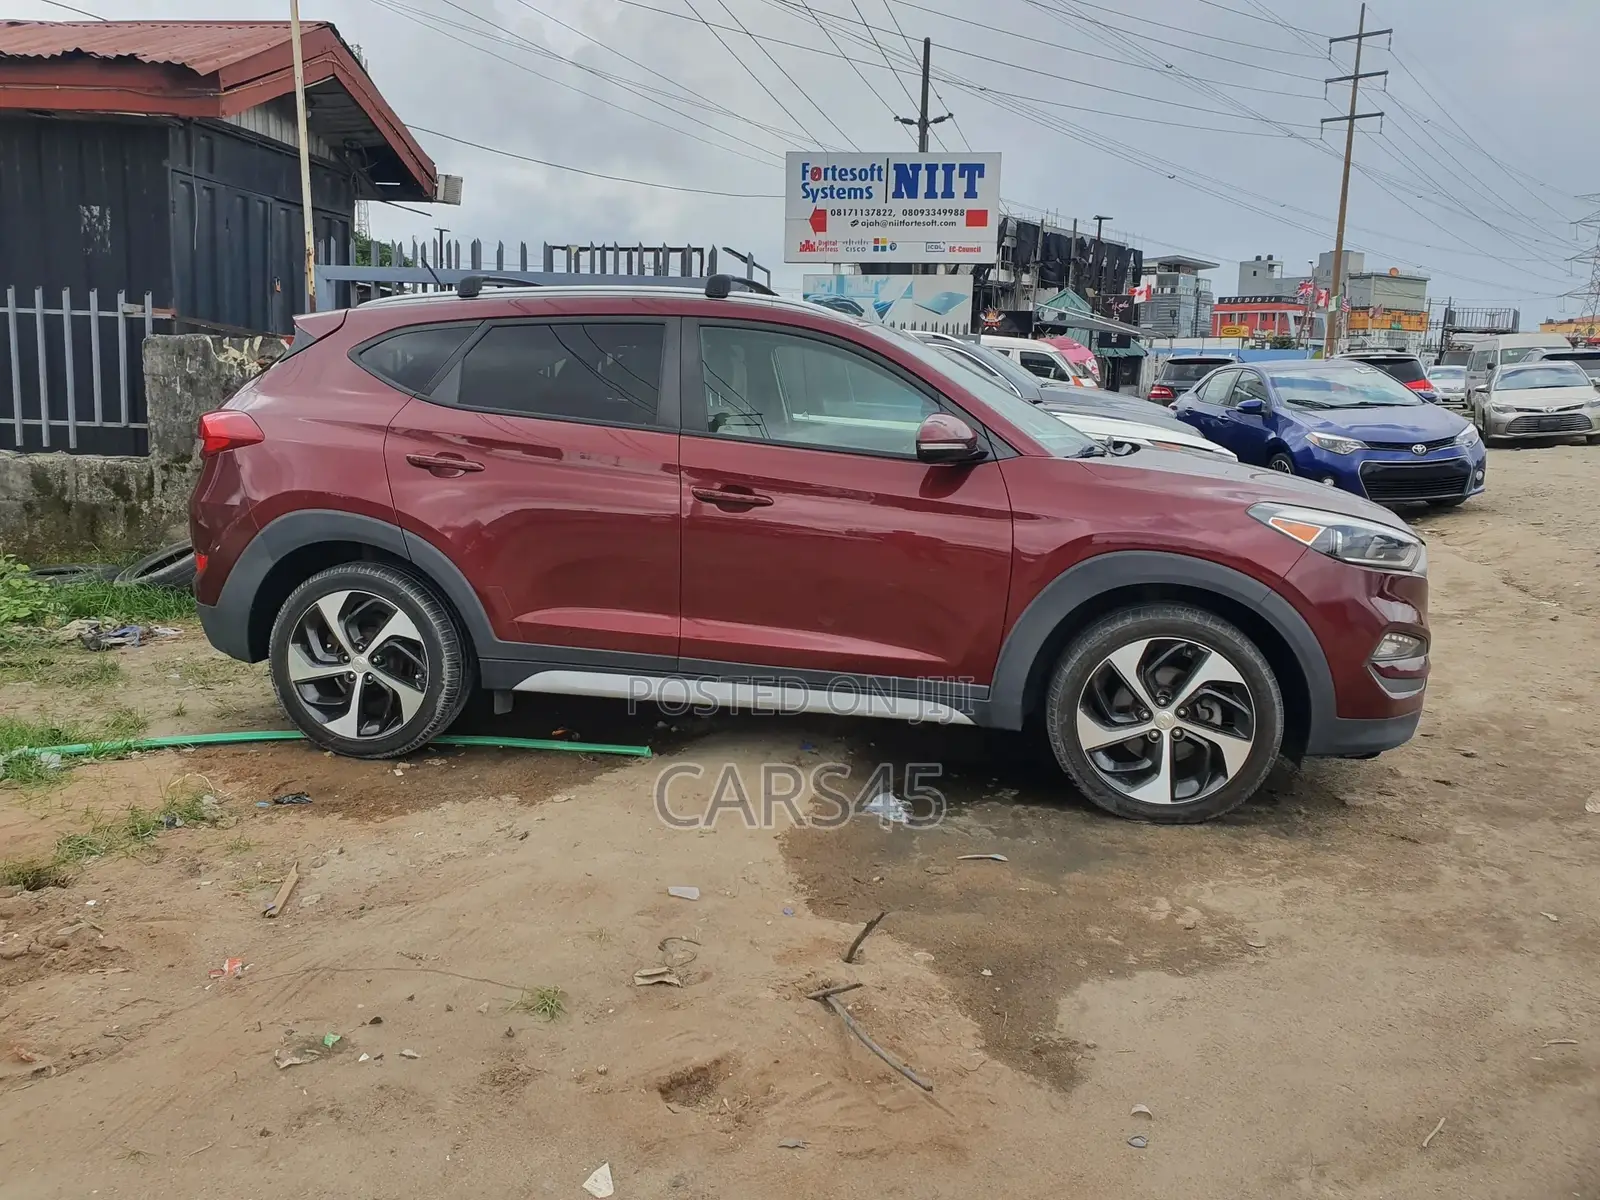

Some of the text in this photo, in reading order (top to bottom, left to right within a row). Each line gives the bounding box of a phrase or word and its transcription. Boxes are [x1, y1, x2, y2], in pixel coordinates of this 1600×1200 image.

[801, 162, 884, 182] Fortesoft
[892, 163, 985, 199] NIIT
[801, 182, 874, 203] Systems
[830, 208, 965, 218] 08171137822, 08093349988
[860, 219, 957, 229] ajah@niitfortesoft.com
[949, 245, 982, 253] EC-Council
